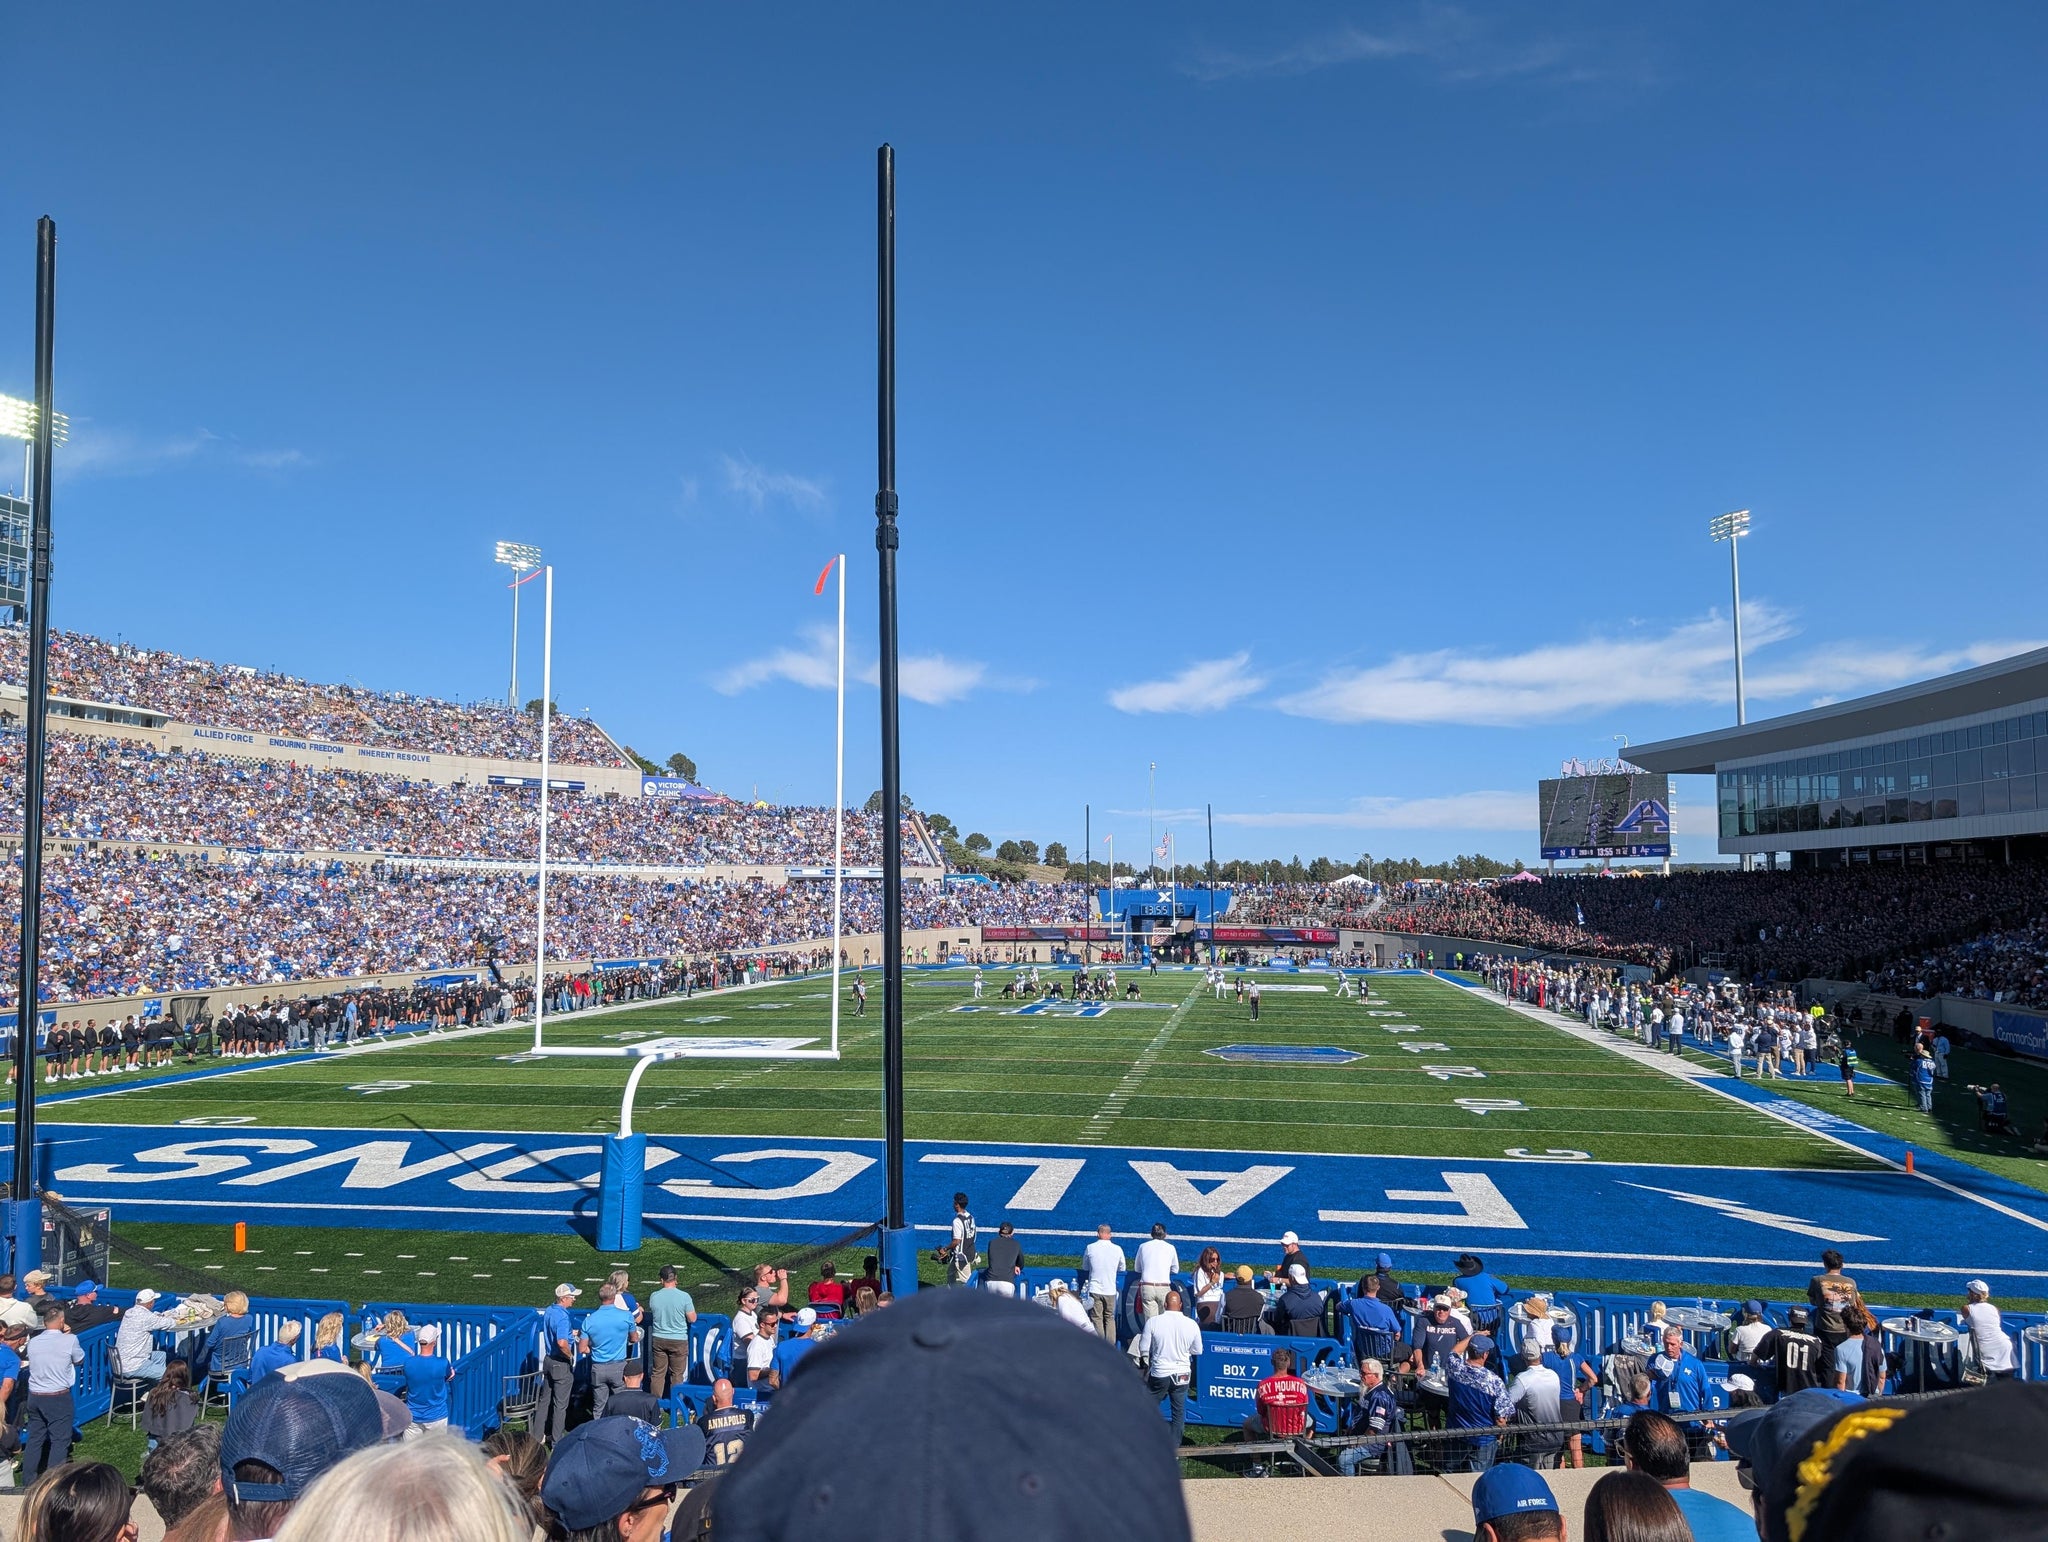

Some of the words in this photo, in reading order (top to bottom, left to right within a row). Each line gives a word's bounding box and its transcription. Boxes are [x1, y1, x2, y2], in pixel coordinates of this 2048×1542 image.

[193, 728, 224, 741] ALLIED
[224, 732, 254, 744] FORCE
[269, 738, 307, 750] ENDURING
[309, 743, 344, 754] FREEDOM
[358, 748, 395, 760] INHERENT
[396, 752, 431, 763] RESOLVE
[1588, 758, 1640, 776] USAA
[1996, 1026, 2046, 1051] CommonSpirit
[54, 1138, 1527, 1229] FALCONS
[1426, 1325, 1436, 1333] AIR
[1214, 1345, 1230, 1353] SOUTH
[1786, 1341, 1809, 1370] 01
[1223, 1364, 1246, 1377] BOX
[1251, 1366, 1260, 1377] 7
[708, 1414, 746, 1429] ANNAPOLIS
[1517, 1499, 1528, 1507] AIR
[1528, 1498, 1548, 1506] FORCE
